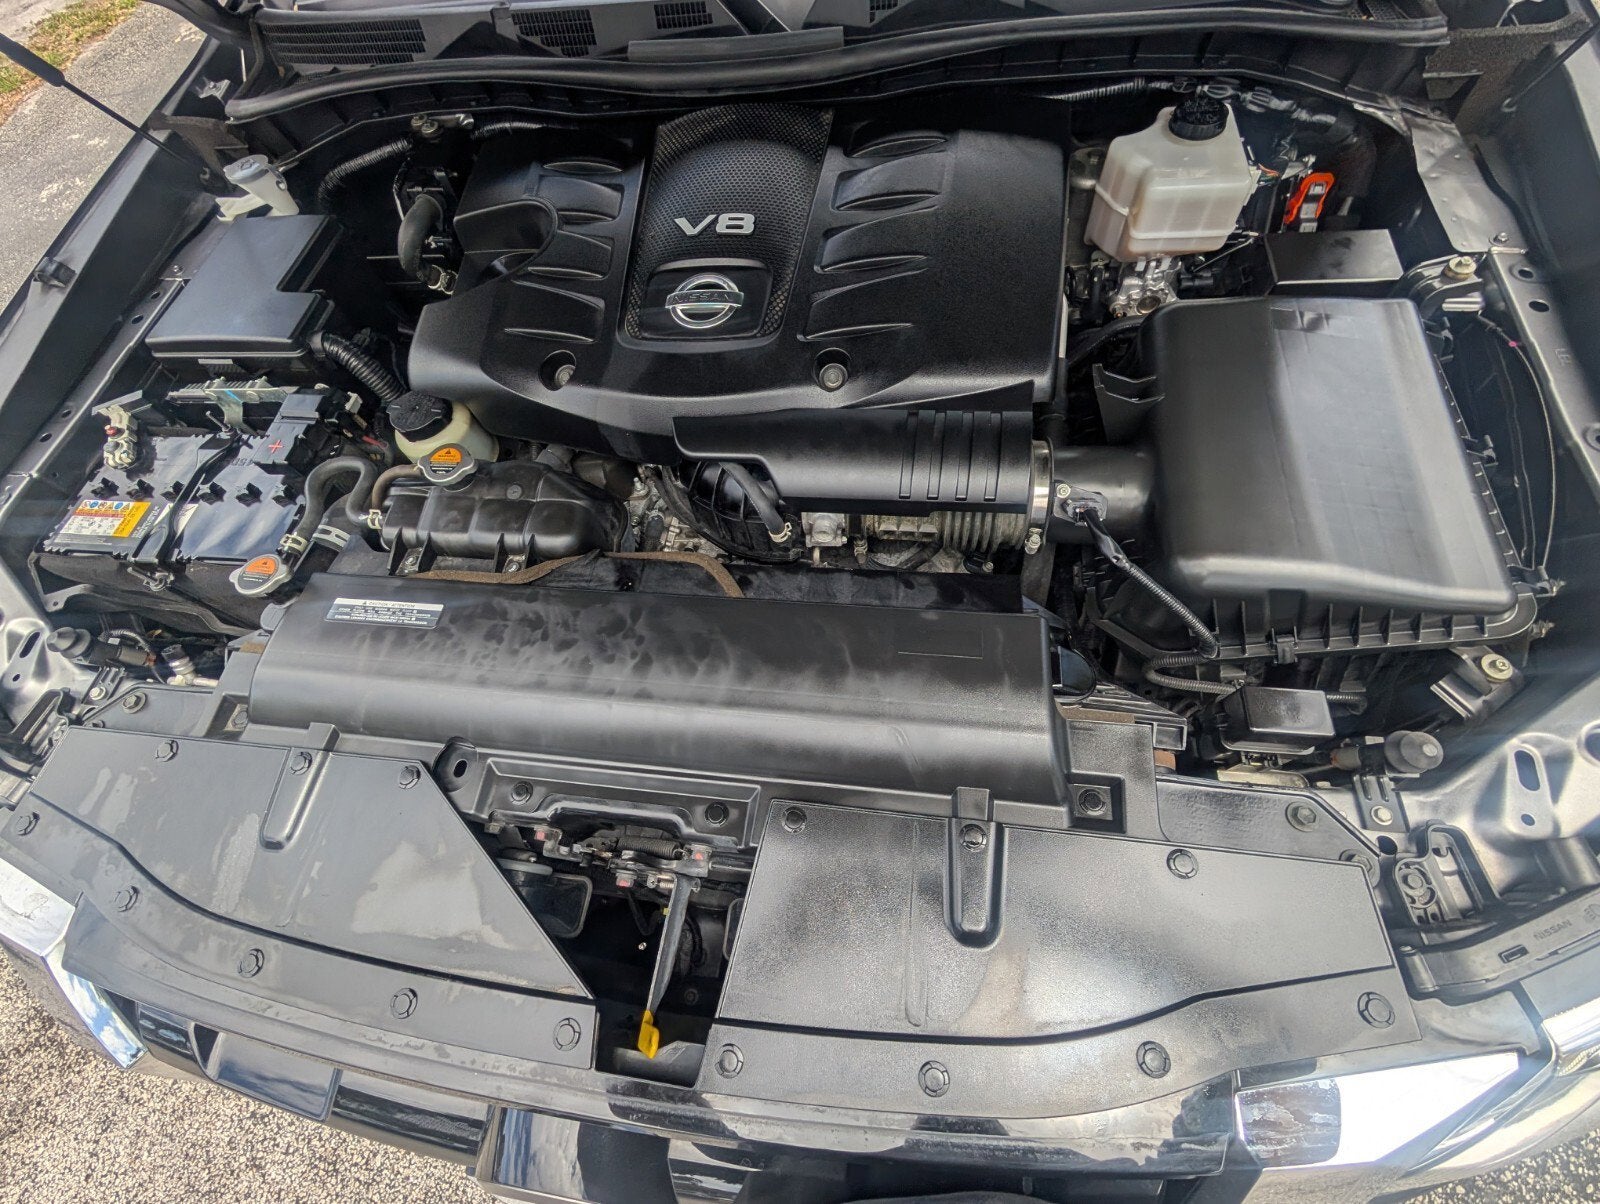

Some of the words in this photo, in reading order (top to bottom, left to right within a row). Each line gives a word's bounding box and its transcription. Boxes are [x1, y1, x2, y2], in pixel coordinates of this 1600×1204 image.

[674, 212, 756, 236] V8
[673, 293, 735, 302] NISSAN
[1533, 919, 1573, 941] NISSAN
